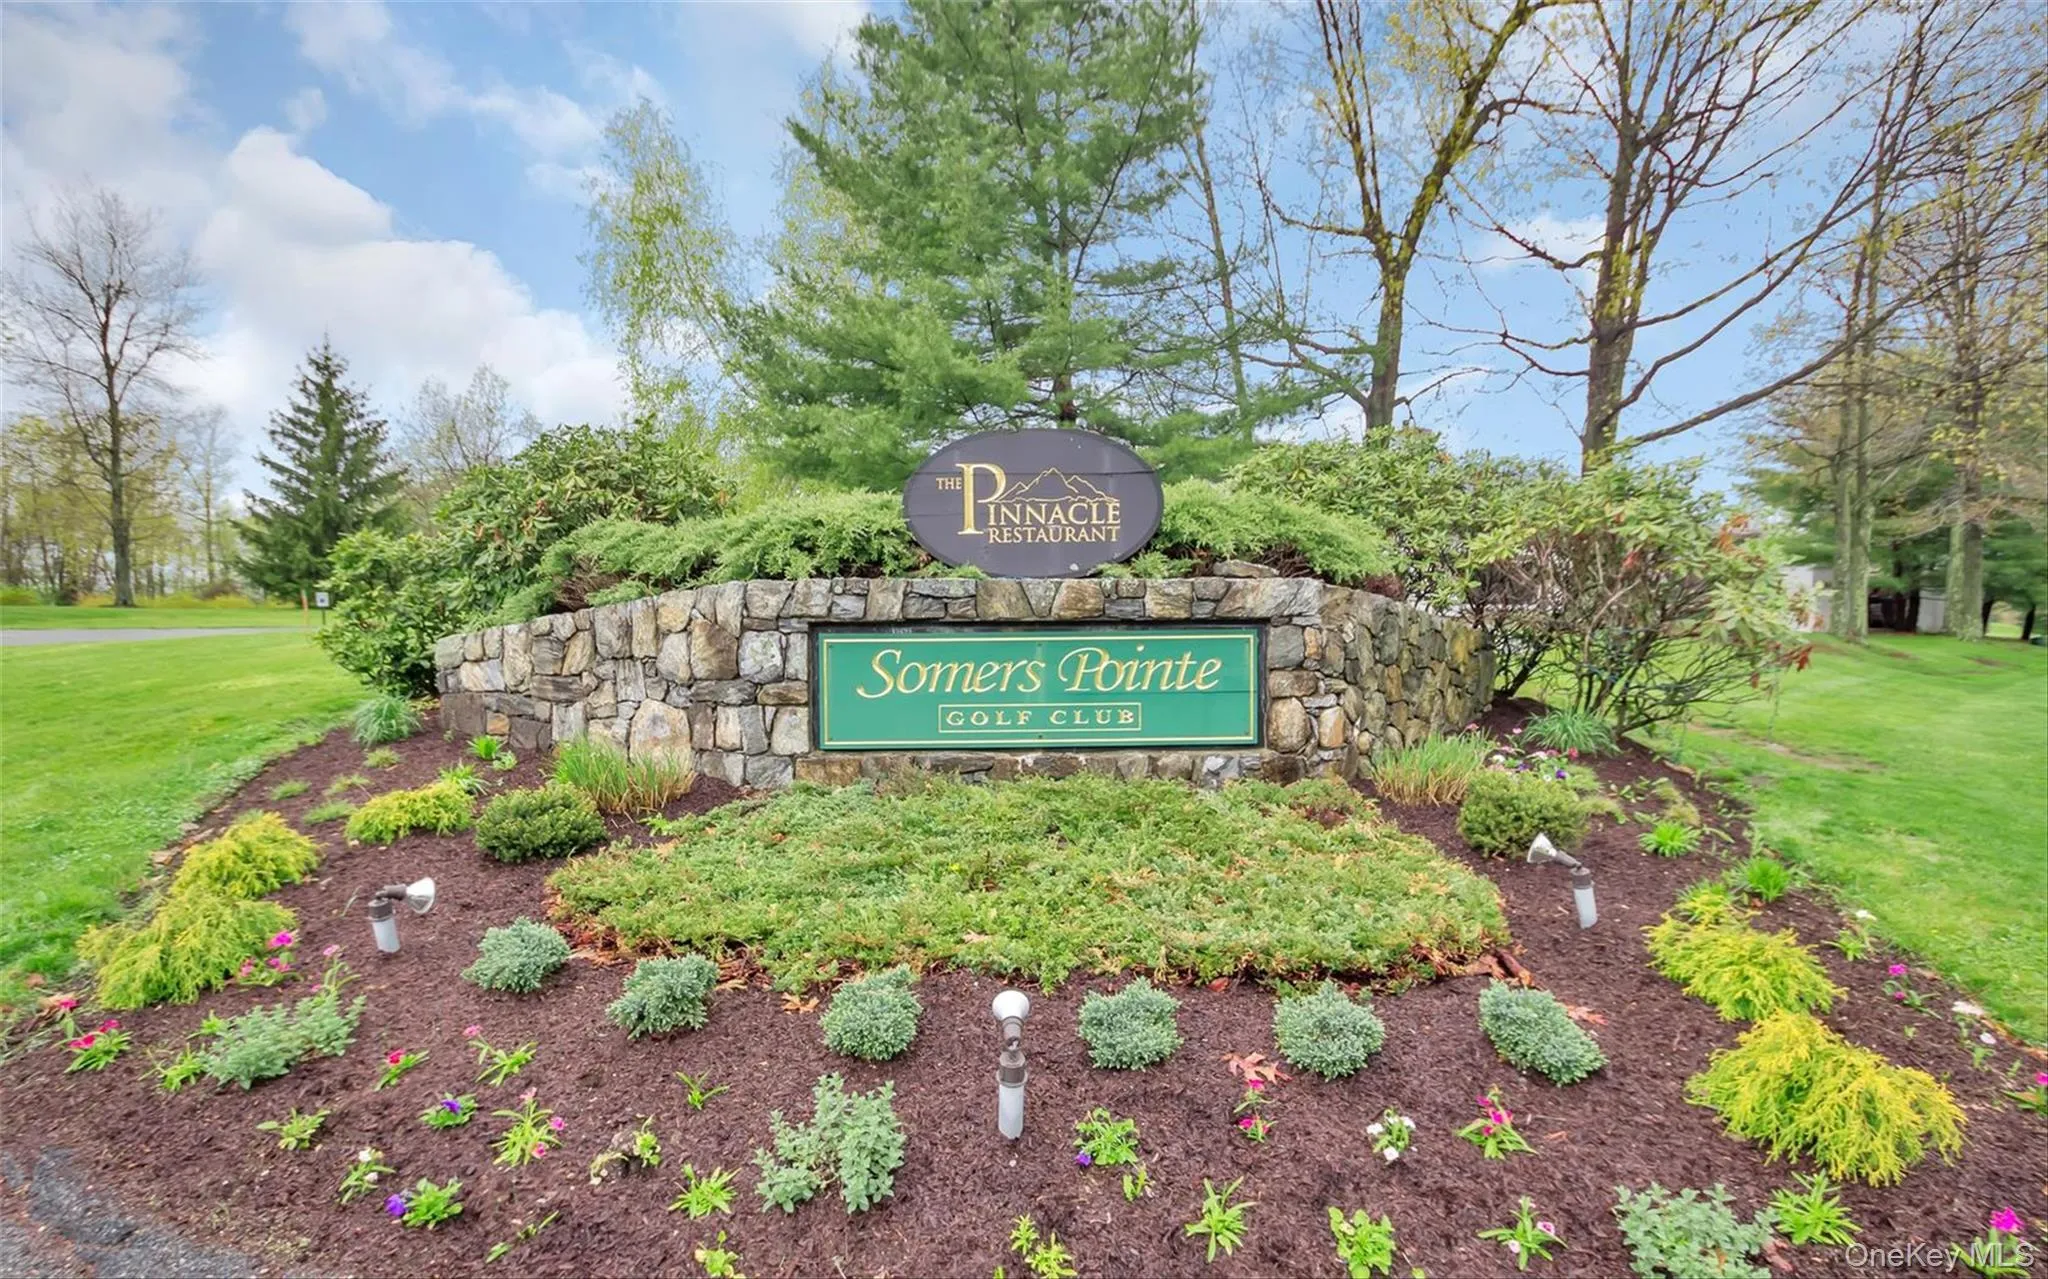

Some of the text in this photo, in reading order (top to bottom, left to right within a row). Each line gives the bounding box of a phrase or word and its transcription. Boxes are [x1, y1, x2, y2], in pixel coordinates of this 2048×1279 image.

[936, 477, 962, 490] THE
[955, 463, 1121, 535] PINNACLE
[988, 526, 1121, 544] RESTAURANT
[856, 644, 1223, 699] Somers Pointe
[945, 708, 1137, 727] GOLF CLUB
